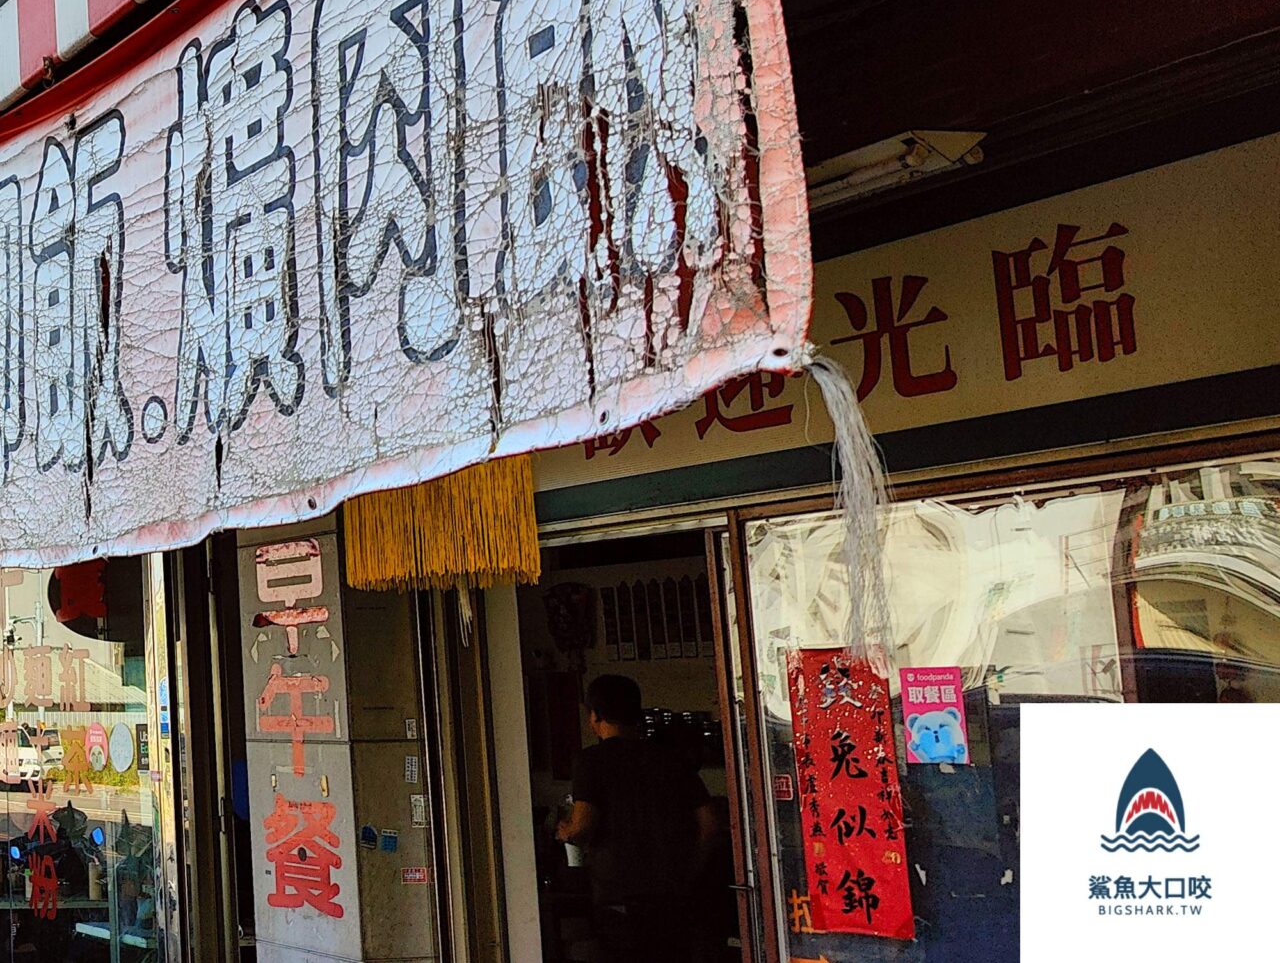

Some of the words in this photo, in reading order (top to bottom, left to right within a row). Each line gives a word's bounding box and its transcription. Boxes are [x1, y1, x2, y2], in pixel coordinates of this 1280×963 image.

[917, 673, 954, 682] foodpanda
[907, 685, 958, 704] 取餐區
[252, 538, 345, 920] 早午餐
